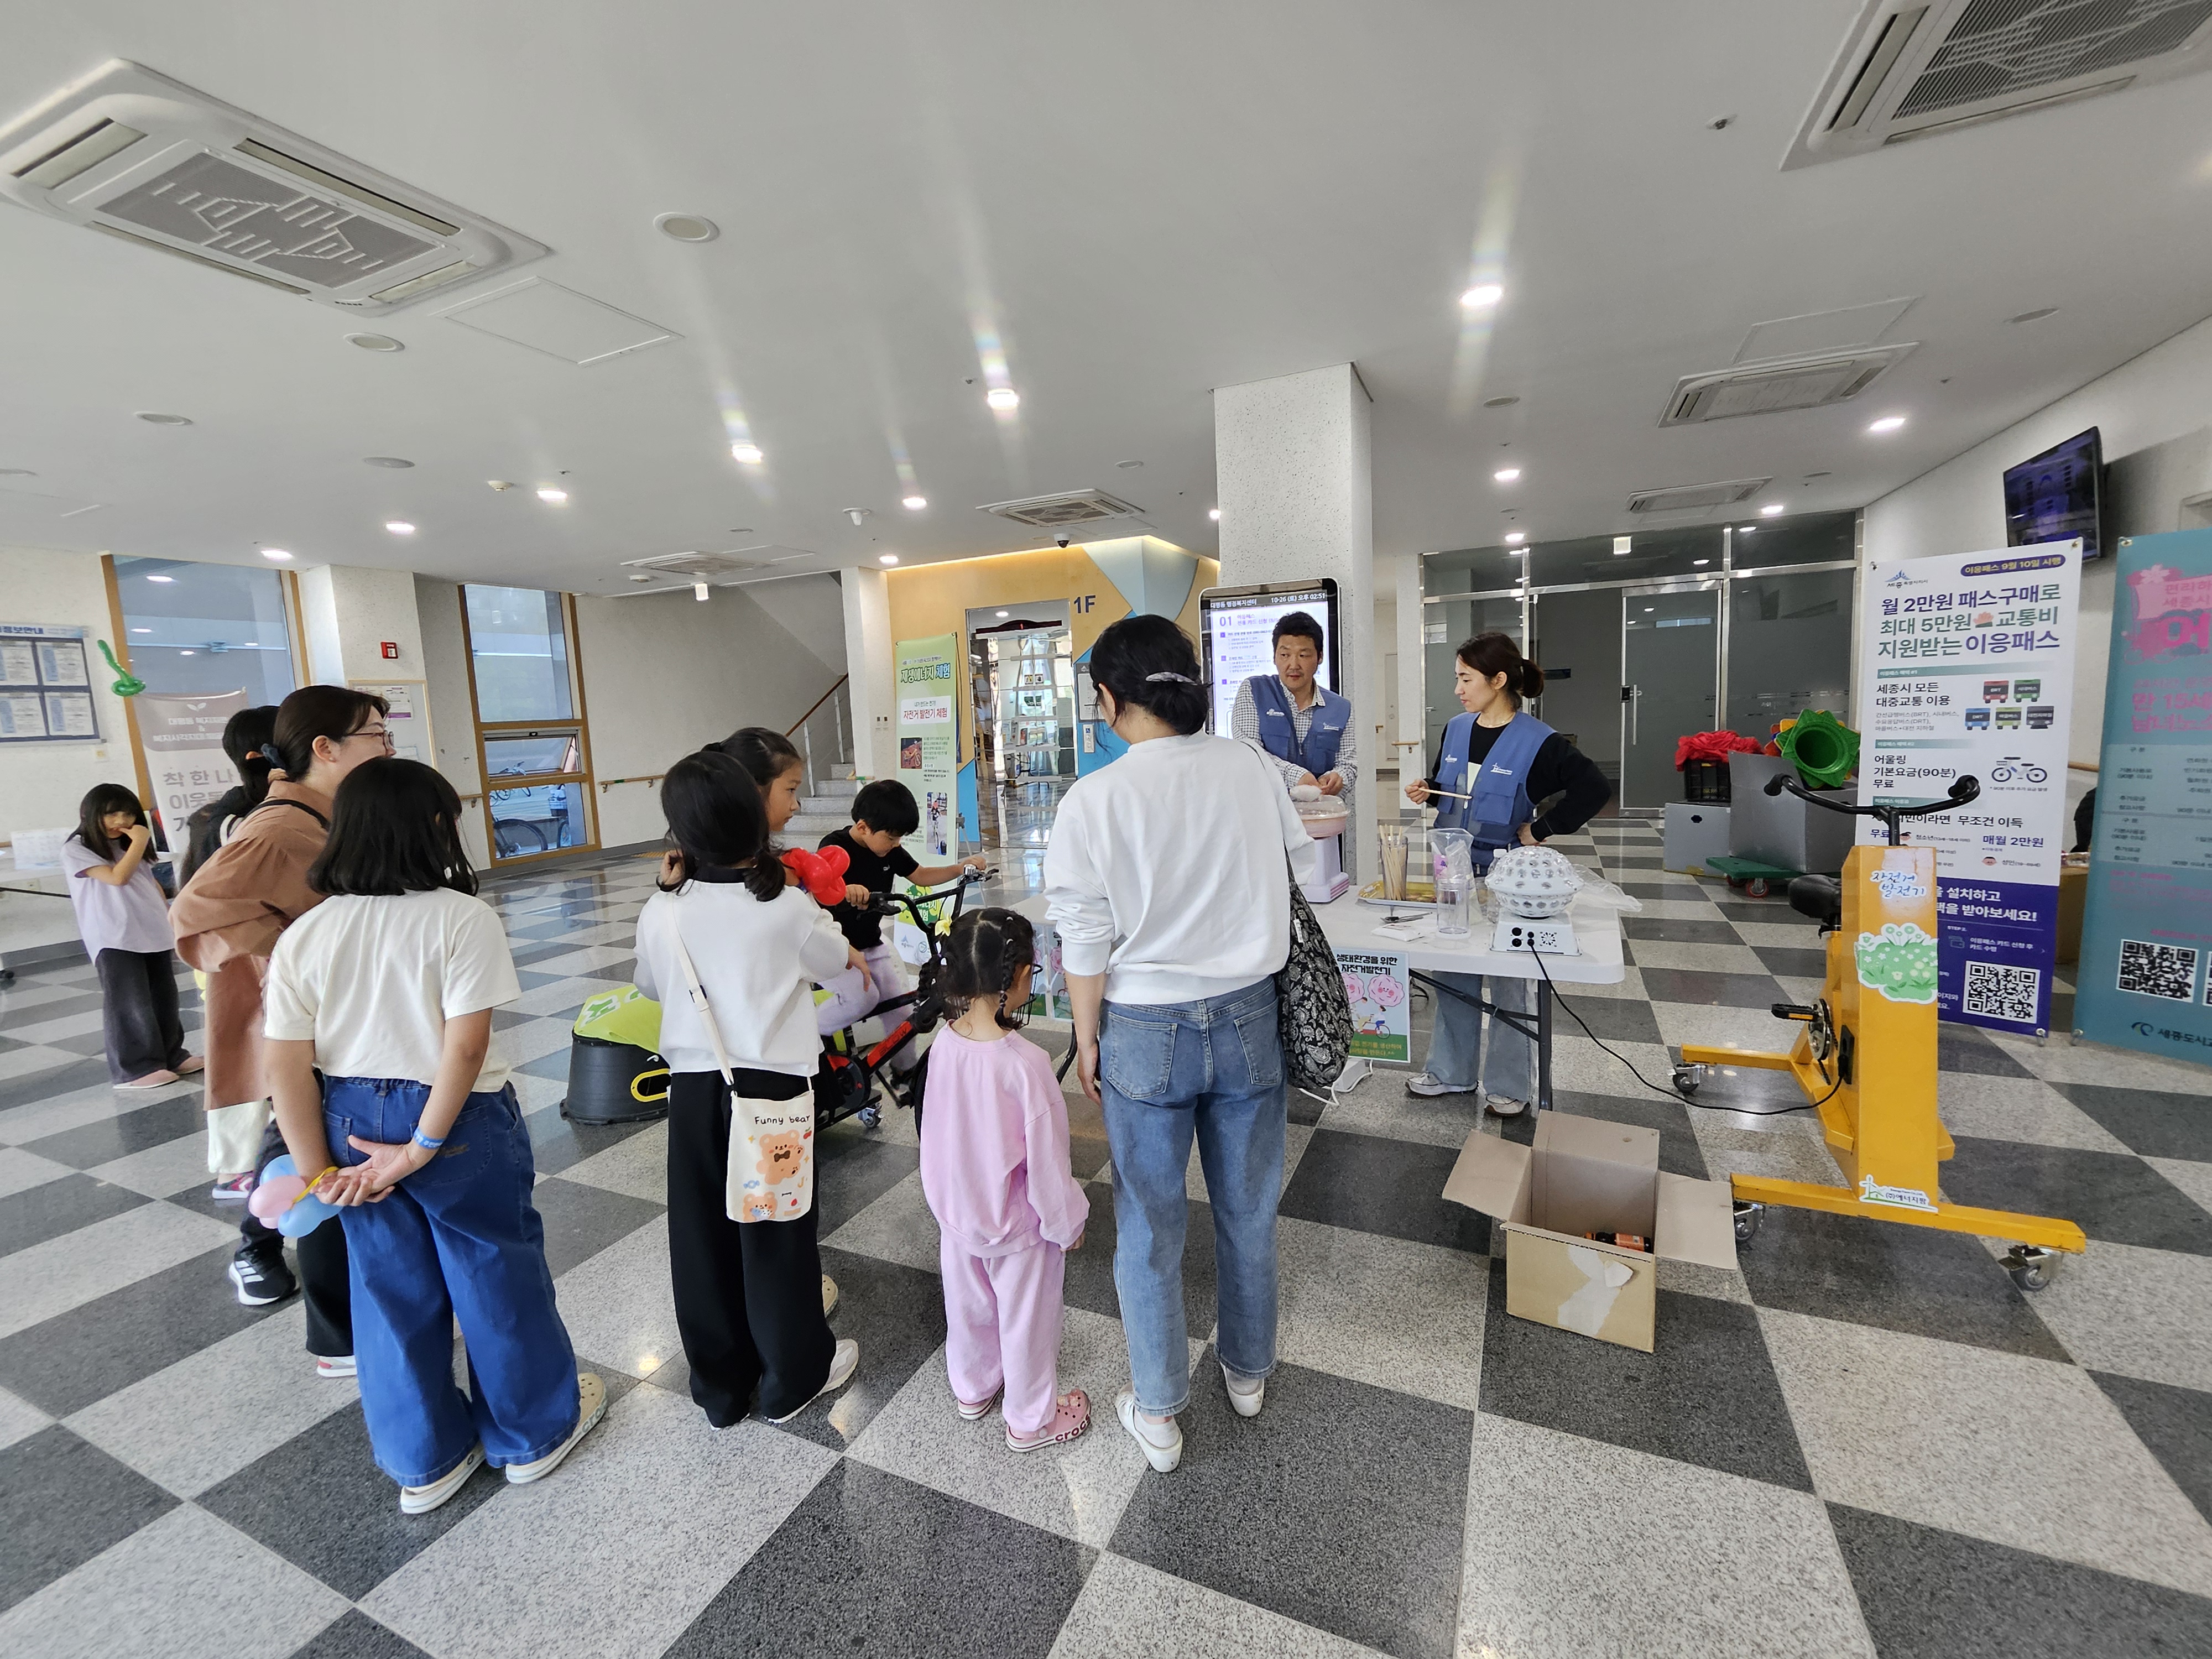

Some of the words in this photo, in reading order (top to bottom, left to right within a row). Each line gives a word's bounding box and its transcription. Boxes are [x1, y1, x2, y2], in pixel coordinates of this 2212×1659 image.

[2020, 559, 2039, 568] 10일
[1073, 594, 1096, 614] 1F
[1881, 598, 1898, 615] 월
[1904, 593, 1953, 612] 2만원
[1958, 584, 2061, 608] 패스구매로
[1219, 616, 1232, 627] 01
[1880, 618, 1915, 636] 최대
[1921, 613, 1972, 632] 5만원
[1996, 606, 2058, 627] 교통비
[1878, 636, 1963, 659] 지원받는
[1965, 630, 2060, 654] 이응패스
[901, 665, 935, 683] 재생에너지
[935, 662, 951, 679] 체험
[1876, 683, 1911, 694] 세종시
[1914, 682, 1939, 693] 모든
[1876, 696, 1923, 707] 대중교통
[1926, 695, 1951, 706] 이용
[904, 709, 919, 719] 자전거
[920, 708, 936, 719] 발전기
[936, 707, 948, 718] 체험
[1874, 755, 1906, 765] 어울링
[1874, 767, 1956, 779] 기본요금(90분)
[1872, 779, 1895, 788] 무료
[1958, 816, 1994, 827] 무조건
[1998, 817, 2023, 828] 이득
[1983, 835, 2006, 846] 매월
[2010, 837, 2044, 848] 2만원
[1872, 872, 1915, 883] 자전거
[1882, 883, 1924, 898] 발전기
[1946, 887, 2001, 901] 설치하고
[1961, 905, 2038, 922] 받아보세요!
[1337, 953, 1379, 964] 생태환경을
[1380, 957, 1398, 966] 위한
[1341, 964, 1391, 975] 자전거발전기
[754, 1116, 784, 1125] Funny
[789, 1115, 810, 1124] bear
[1055, 1413, 1091, 1442] crocs
